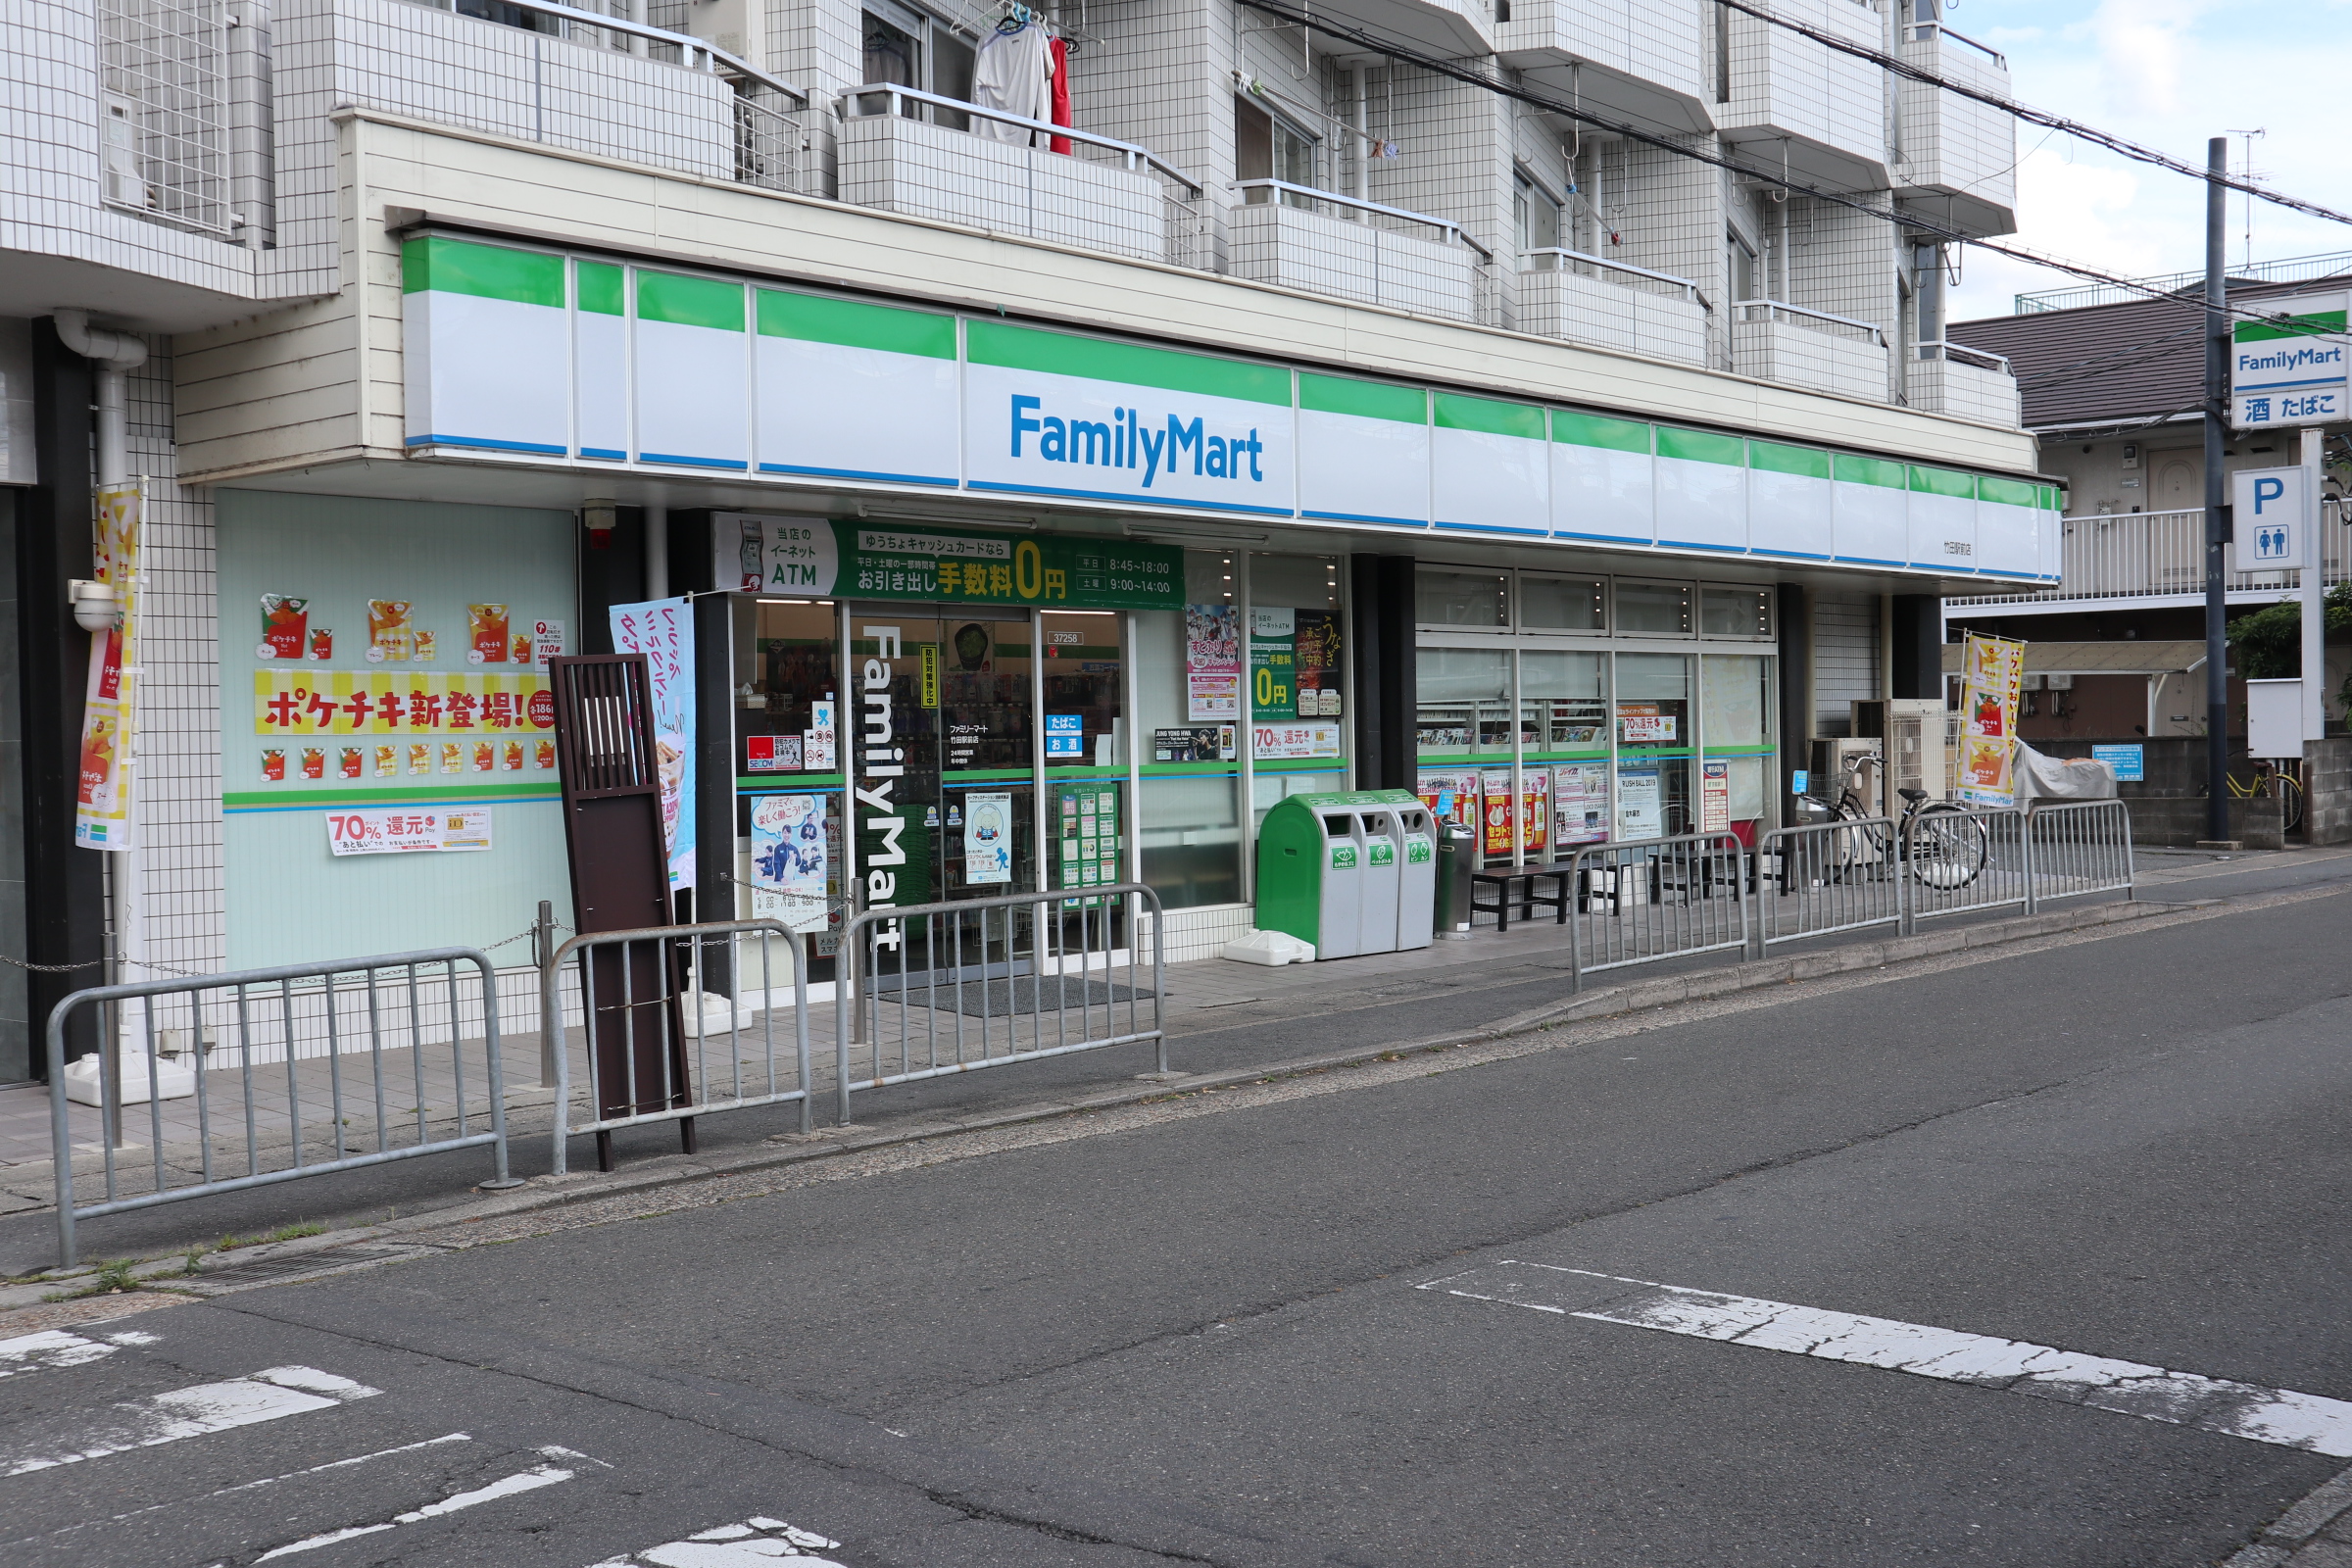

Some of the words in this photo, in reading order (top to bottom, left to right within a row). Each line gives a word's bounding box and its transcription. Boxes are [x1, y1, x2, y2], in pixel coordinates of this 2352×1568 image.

[2239, 347, 2342, 371] FamilyMart
[2245, 398, 2271, 422] 酒
[2281, 394, 2336, 418] たばこ
[1011, 393, 1263, 488] FamilyMart
[2254, 477, 2284, 515] P
[777, 527, 811, 541] 当店の
[770, 545, 816, 559] イーネット
[865, 534, 1004, 556] ゆうちょキャッシュカードなら
[1944, 540, 1972, 556] 竹田駅前店
[858, 557, 936, 570] 平日・土曜の一部時間帯
[1083, 559, 1099, 568] 平日
[771, 564, 816, 586] ATM
[858, 569, 937, 593] お引き出し
[1084, 578, 1100, 588] 土曜
[1054, 633, 1078, 643] 37258
[1305, 627, 1314, 665] 承り中
[1313, 628, 1322, 665] ご予約
[1323, 614, 1342, 667] うなぎ
[539, 644, 561, 653] 110番
[925, 648, 934, 706] 防犯対策強化中
[265, 687, 524, 728] ポケチキ新登場!
[950, 724, 989, 734] ファミリーマート
[1052, 716, 1077, 729] たばこ
[951, 736, 979, 745] 竹田駅前店
[1284, 729, 1303, 744] 還元
[749, 760, 773, 768] SECOM
[765, 797, 794, 812] ファミマで
[758, 806, 801, 826] 楽しく働こう!
[329, 815, 382, 841] 70%
[386, 815, 423, 836] 還元
